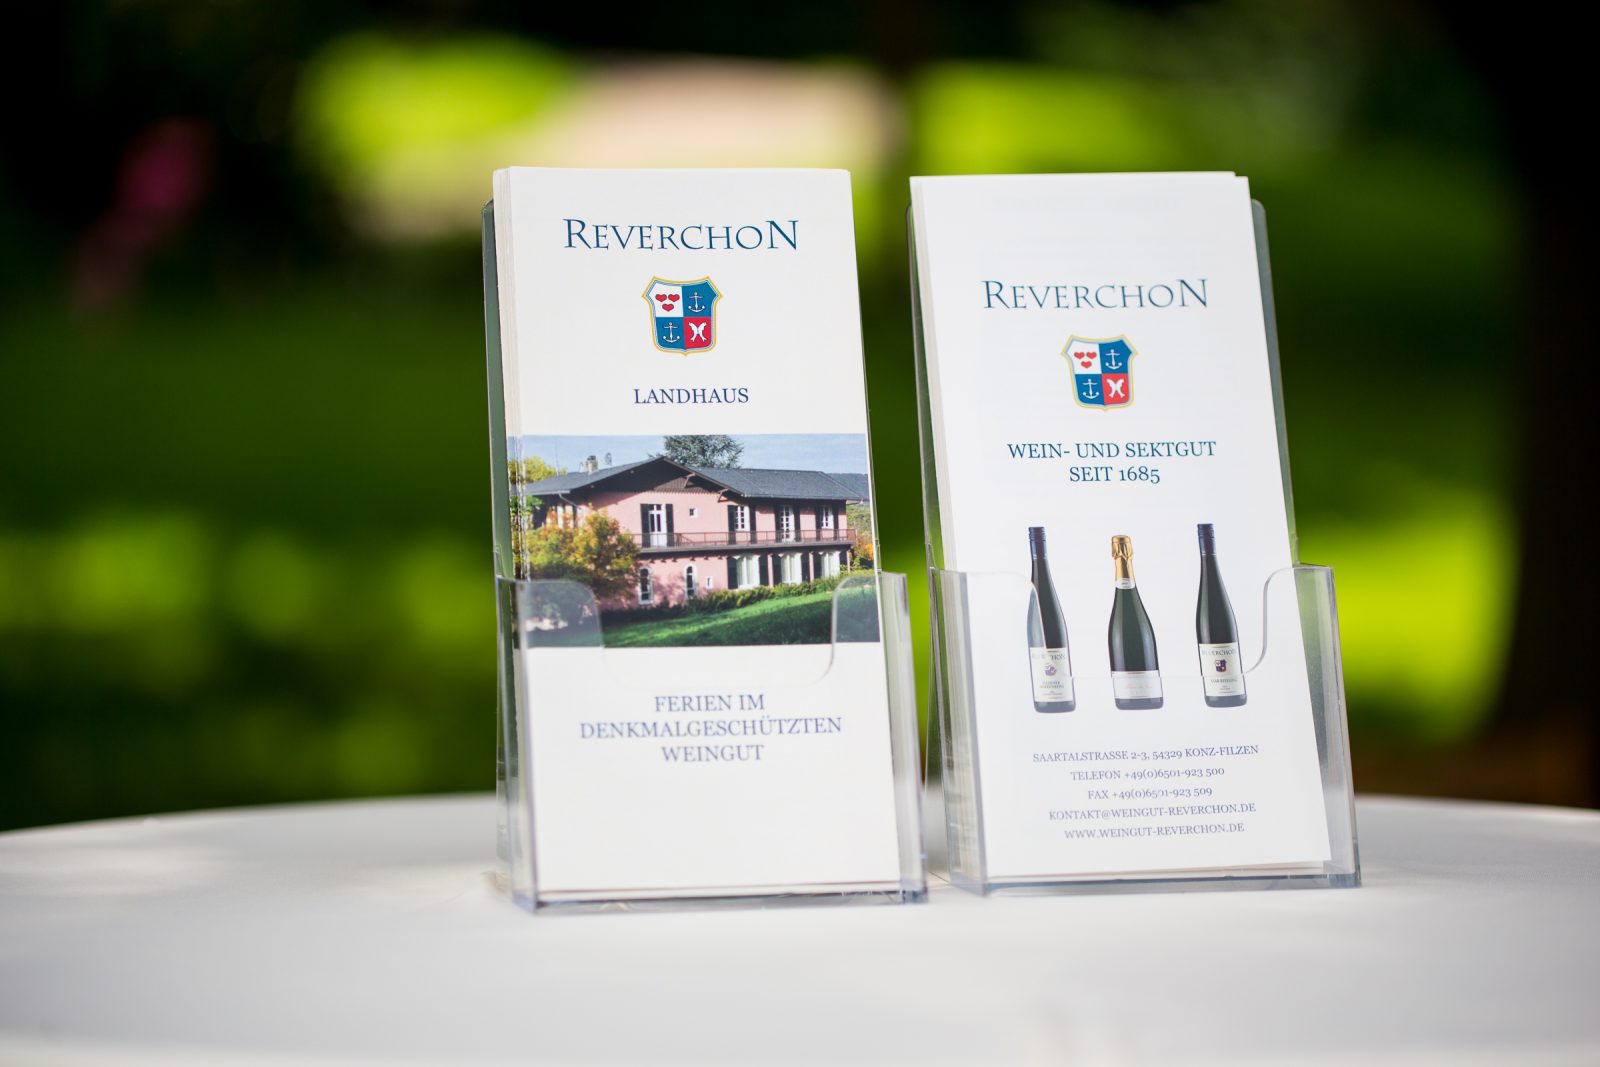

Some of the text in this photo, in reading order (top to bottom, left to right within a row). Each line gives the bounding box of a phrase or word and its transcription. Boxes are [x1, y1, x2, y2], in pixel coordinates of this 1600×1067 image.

[563, 218, 800, 251] REVERCHON
[982, 279, 1208, 309] REVERCHON
[633, 387, 749, 405] LANDHAUS
[1007, 440, 1216, 459] WEIN- UND SEKTGUT
[1069, 466, 1160, 484] SEIT 1685
[655, 694, 765, 713] FERIEN IM
[580, 716, 842, 740] DENKMALGESCHÜTZTEN
[661, 745, 765, 763] WEINGUT
[1033, 745, 1259, 762] SAARTALSTRASSE 2-3, 54329 KONZ-FILZEN
[1070, 770, 1121, 781] TELEFON
[1205, 767, 1224, 777] 500
[1088, 790, 1109, 800] FAX
[1194, 787, 1212, 797] 509
[1049, 803, 1256, 820] KONTAKT@WEINGUT-REVERCHON.DE
[1064, 823, 1245, 839] WWW.WEINGUT-REVERCHON.DE
